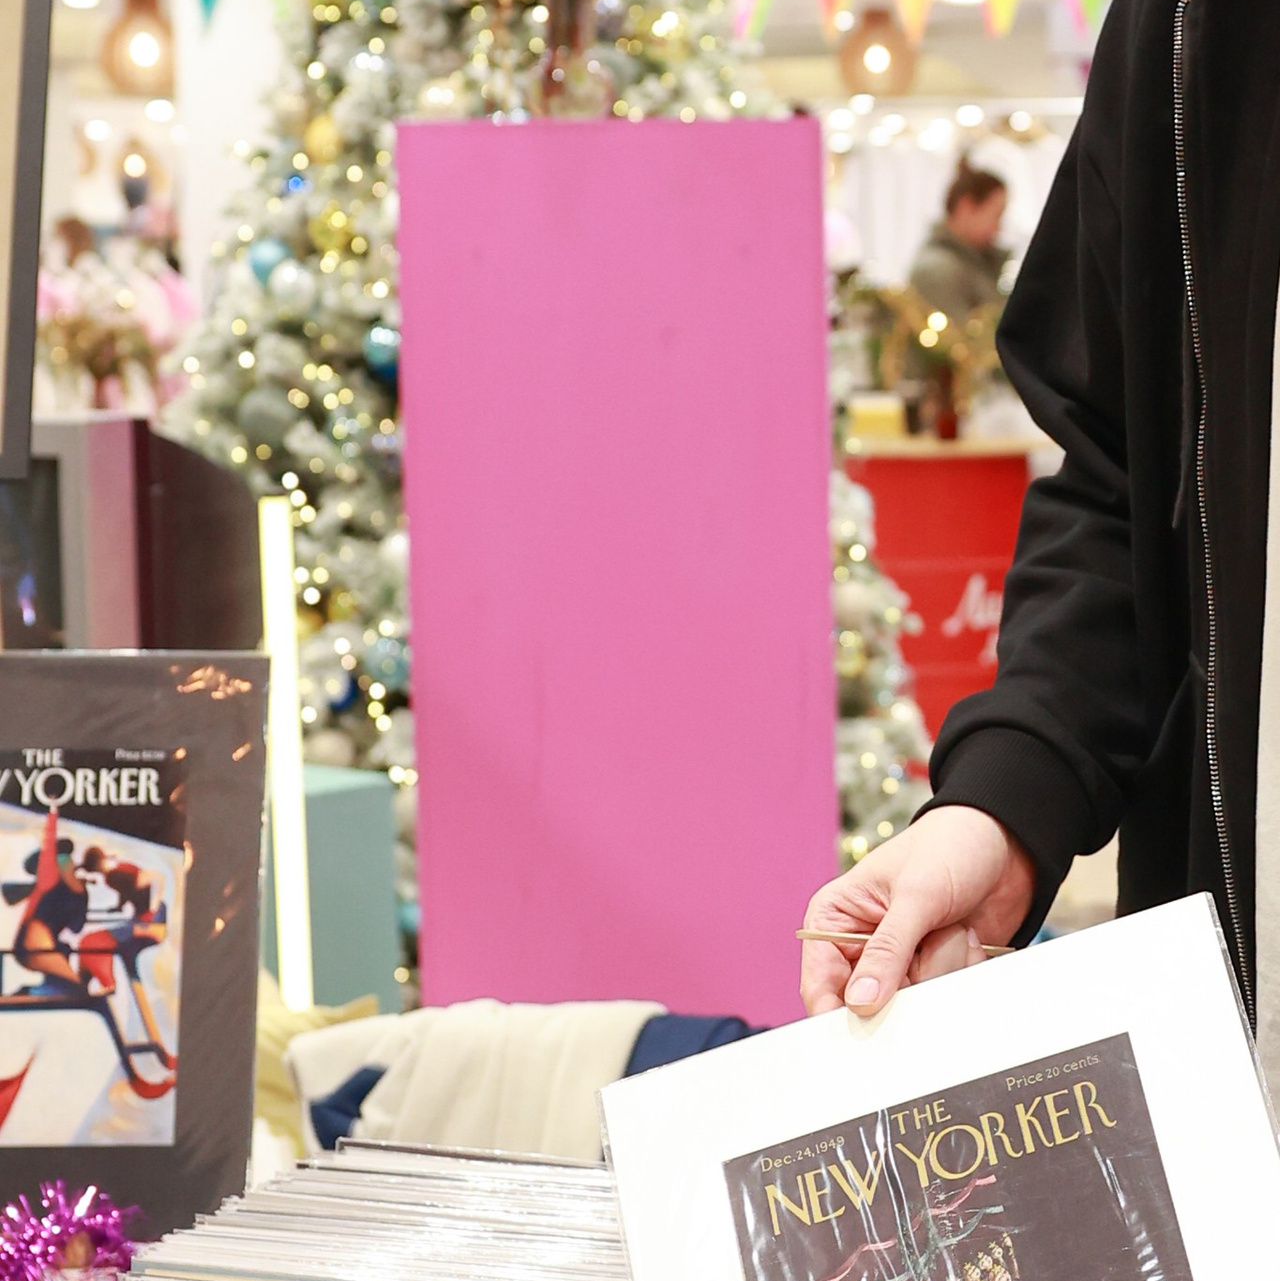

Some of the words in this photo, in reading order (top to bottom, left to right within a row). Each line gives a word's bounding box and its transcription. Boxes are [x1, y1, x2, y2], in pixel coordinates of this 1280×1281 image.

[22, 748, 65, 767] THE
[14, 767, 163, 807] YORKER
[1005, 1071, 1044, 1091] Price
[1045, 1066, 1061, 1080] 20
[1062, 1053, 1101, 1074] cents
[891, 1098, 953, 1135] THE
[764, 1147, 889, 1236] NEW
[895, 1080, 1118, 1188] YORKER
